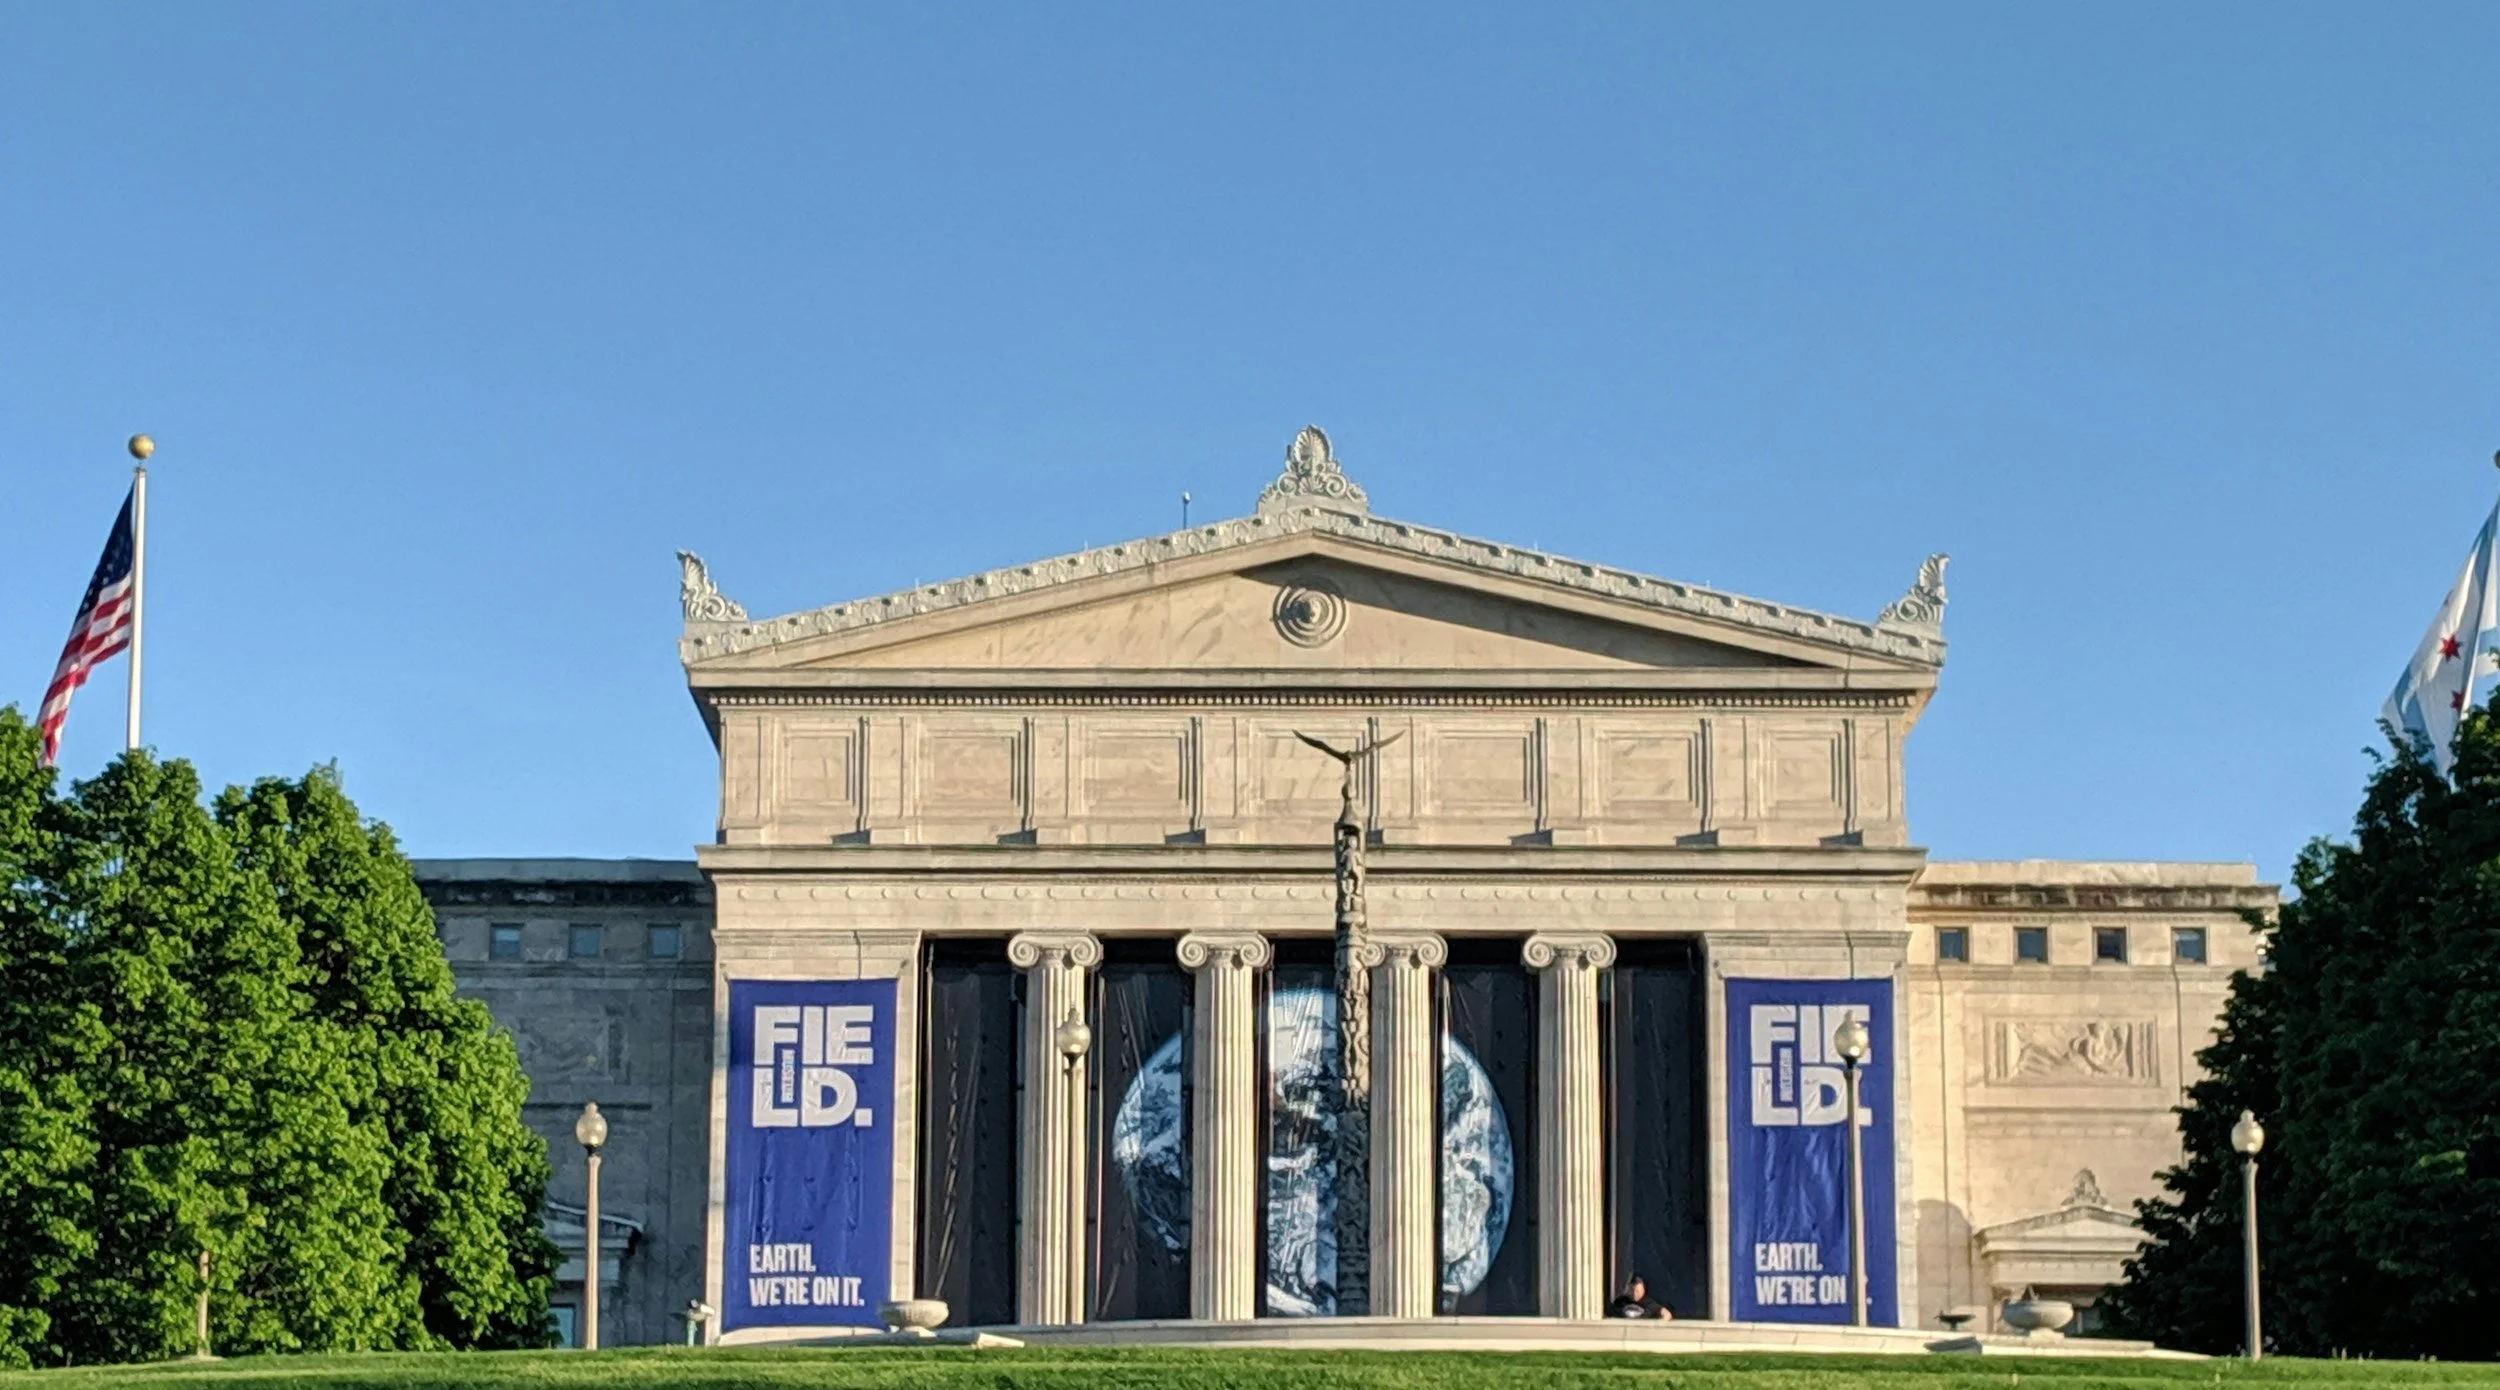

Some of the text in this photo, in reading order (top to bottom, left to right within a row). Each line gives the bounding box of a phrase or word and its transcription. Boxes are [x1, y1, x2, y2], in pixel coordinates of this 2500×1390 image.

[754, 1005, 874, 1065] FIE
[749, 1243, 817, 1273] EARTH.
[1755, 1242, 1823, 1272] EARTH.
[749, 1276, 865, 1307] WE'RE ON IT.
[1755, 1275, 1817, 1305] WE'RE
[1818, 1274, 1847, 1305] ON
